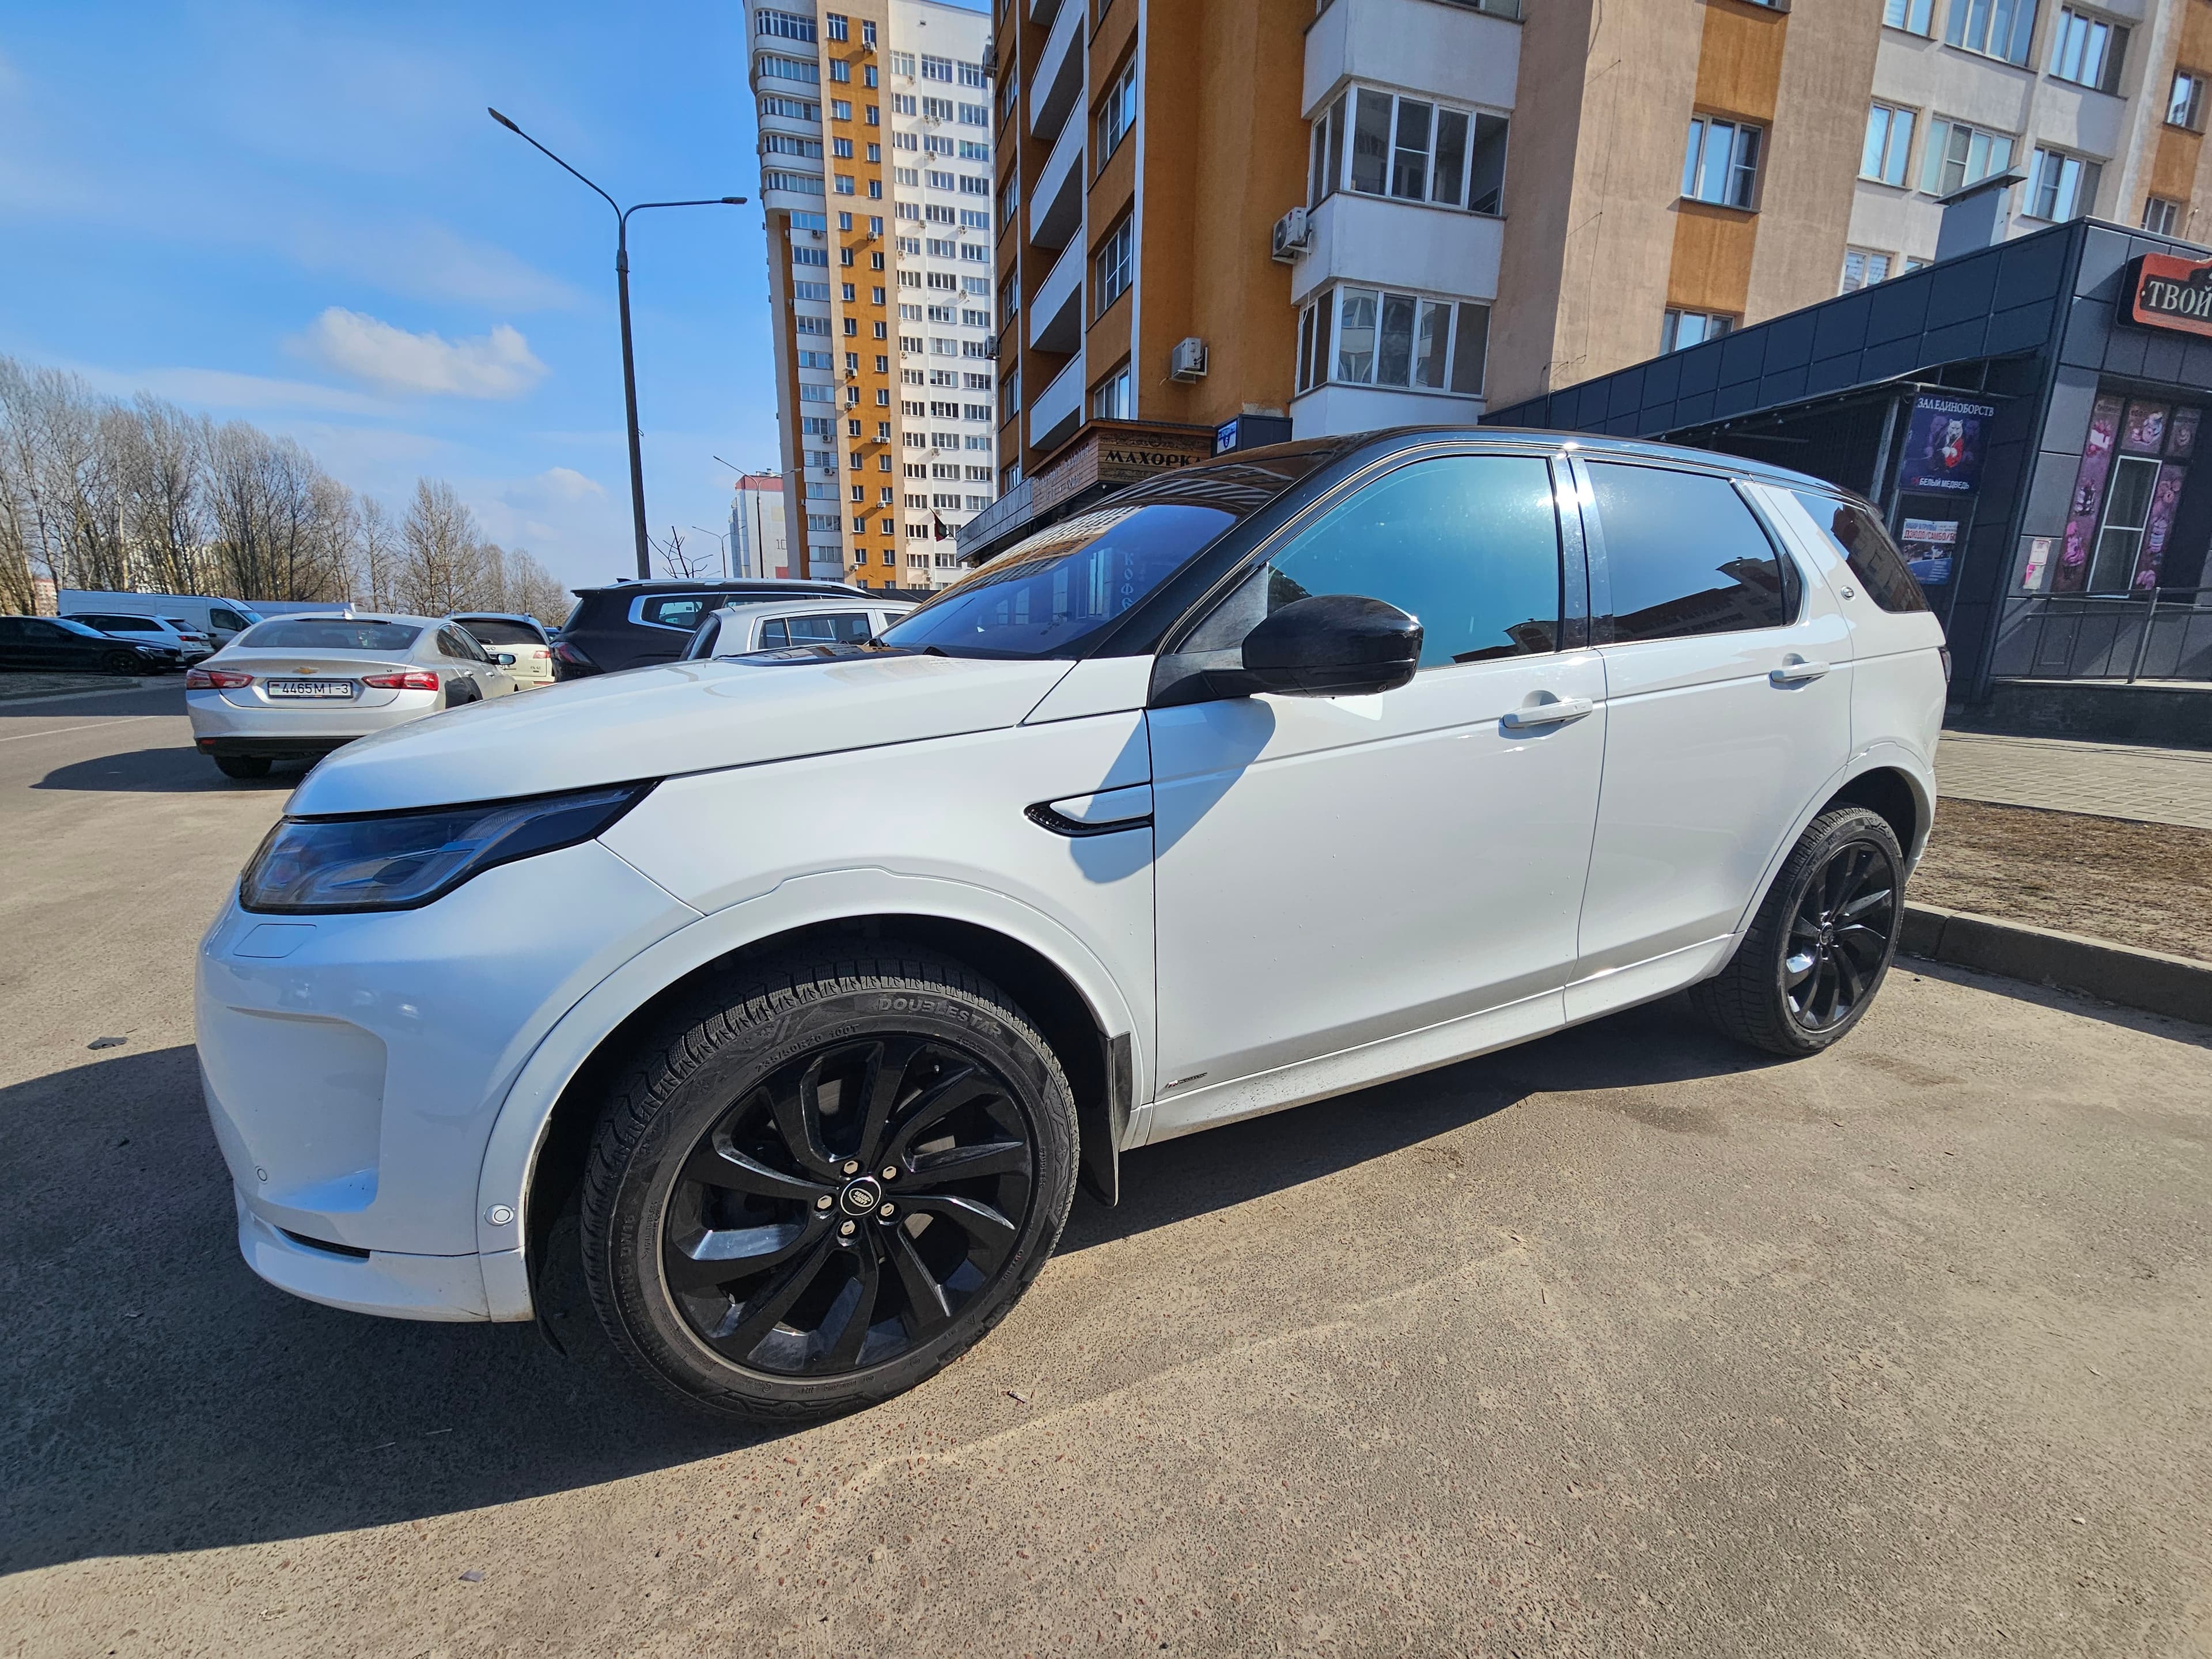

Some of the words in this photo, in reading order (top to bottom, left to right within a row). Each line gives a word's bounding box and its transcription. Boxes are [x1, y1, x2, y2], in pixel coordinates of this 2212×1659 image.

[2149, 281, 2212, 317] ТВОЙ
[1917, 397, 1933, 408] ЗАЛ
[1934, 400, 1994, 417] ЕДИНОБОРСТВ
[1919, 478, 1941, 487] БЕЛЫЙ
[1941, 479, 1969, 490] МЕДВЕДЬ
[878, 998, 1002, 1040] DOUBLESTAR
